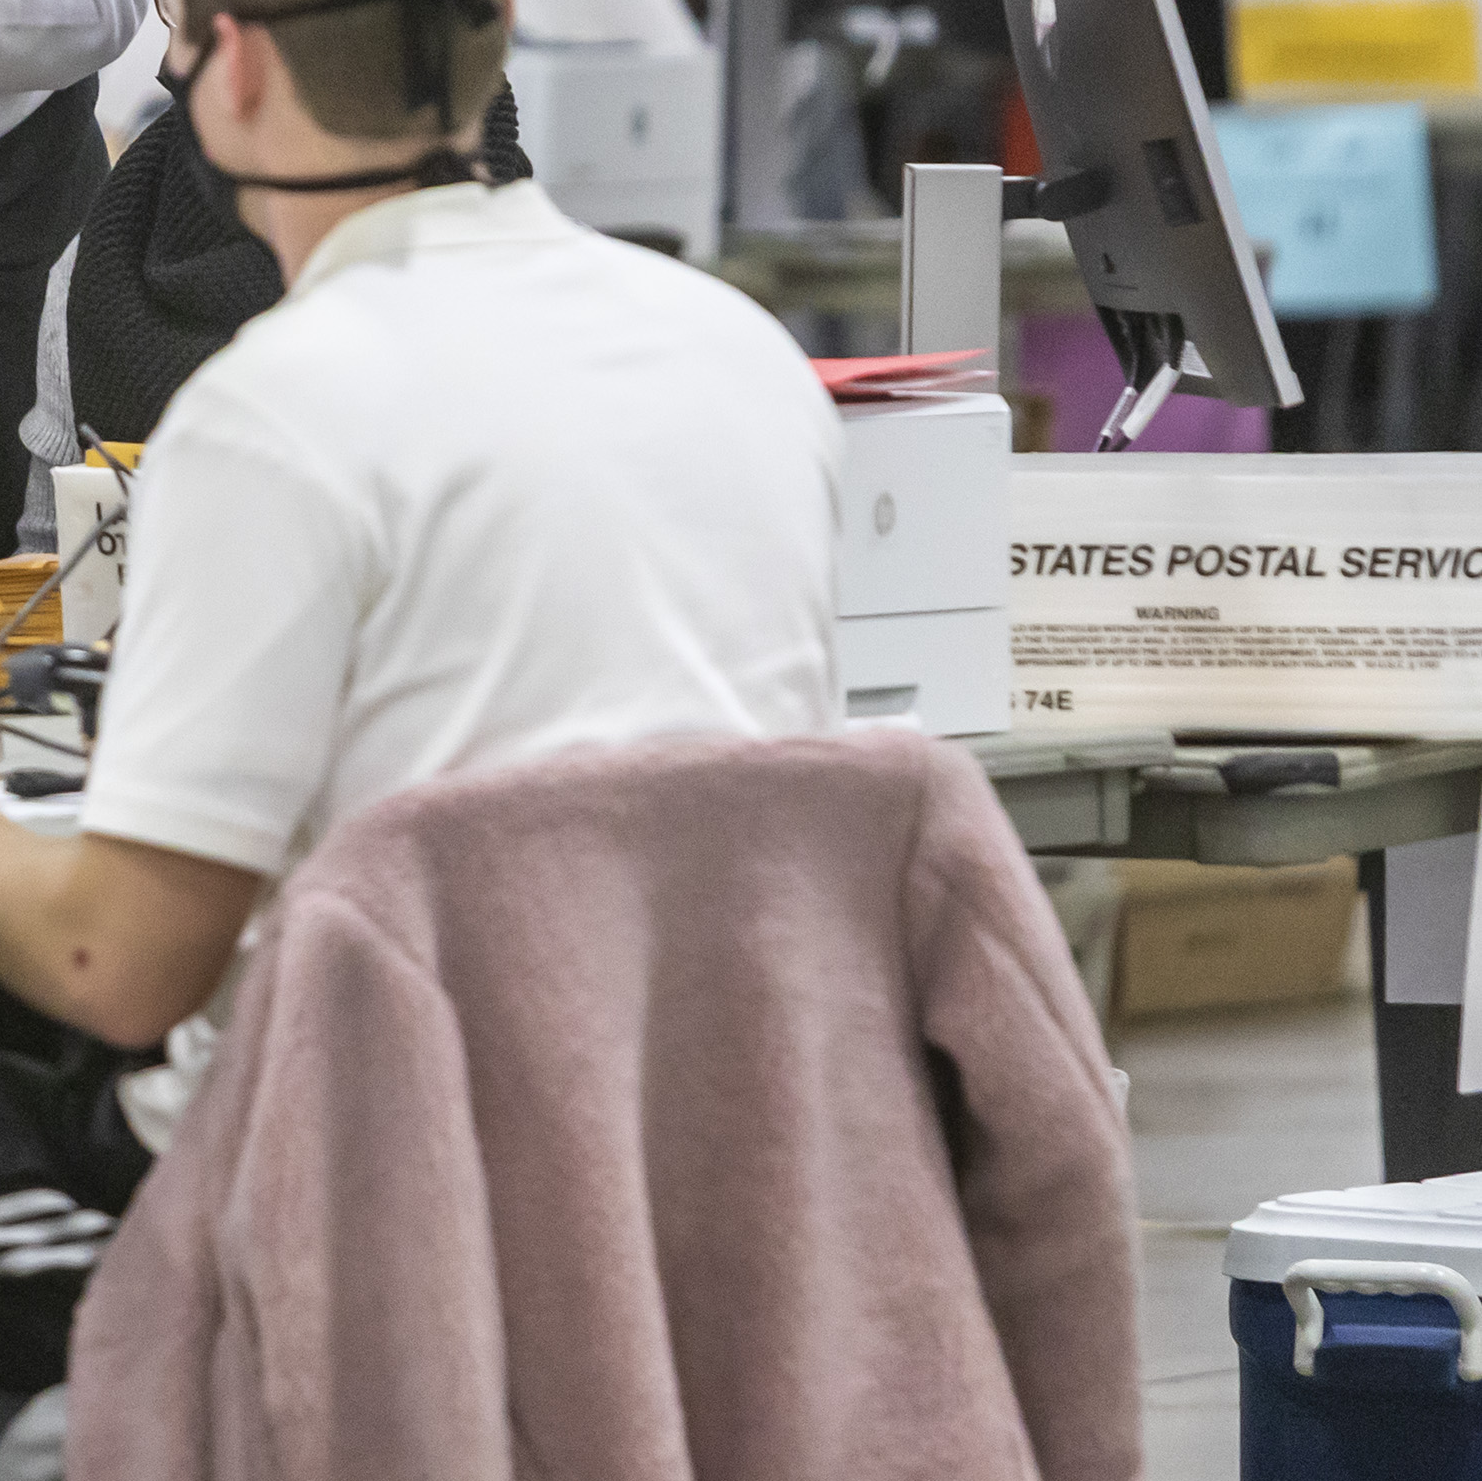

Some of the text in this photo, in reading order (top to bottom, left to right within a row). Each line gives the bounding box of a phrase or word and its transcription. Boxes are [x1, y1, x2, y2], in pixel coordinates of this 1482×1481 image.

[1010, 543, 1154, 576] STATES
[1167, 544, 1327, 578] POSTAL
[1136, 606, 1220, 620] WARNING
[1024, 690, 1073, 711] 74E
